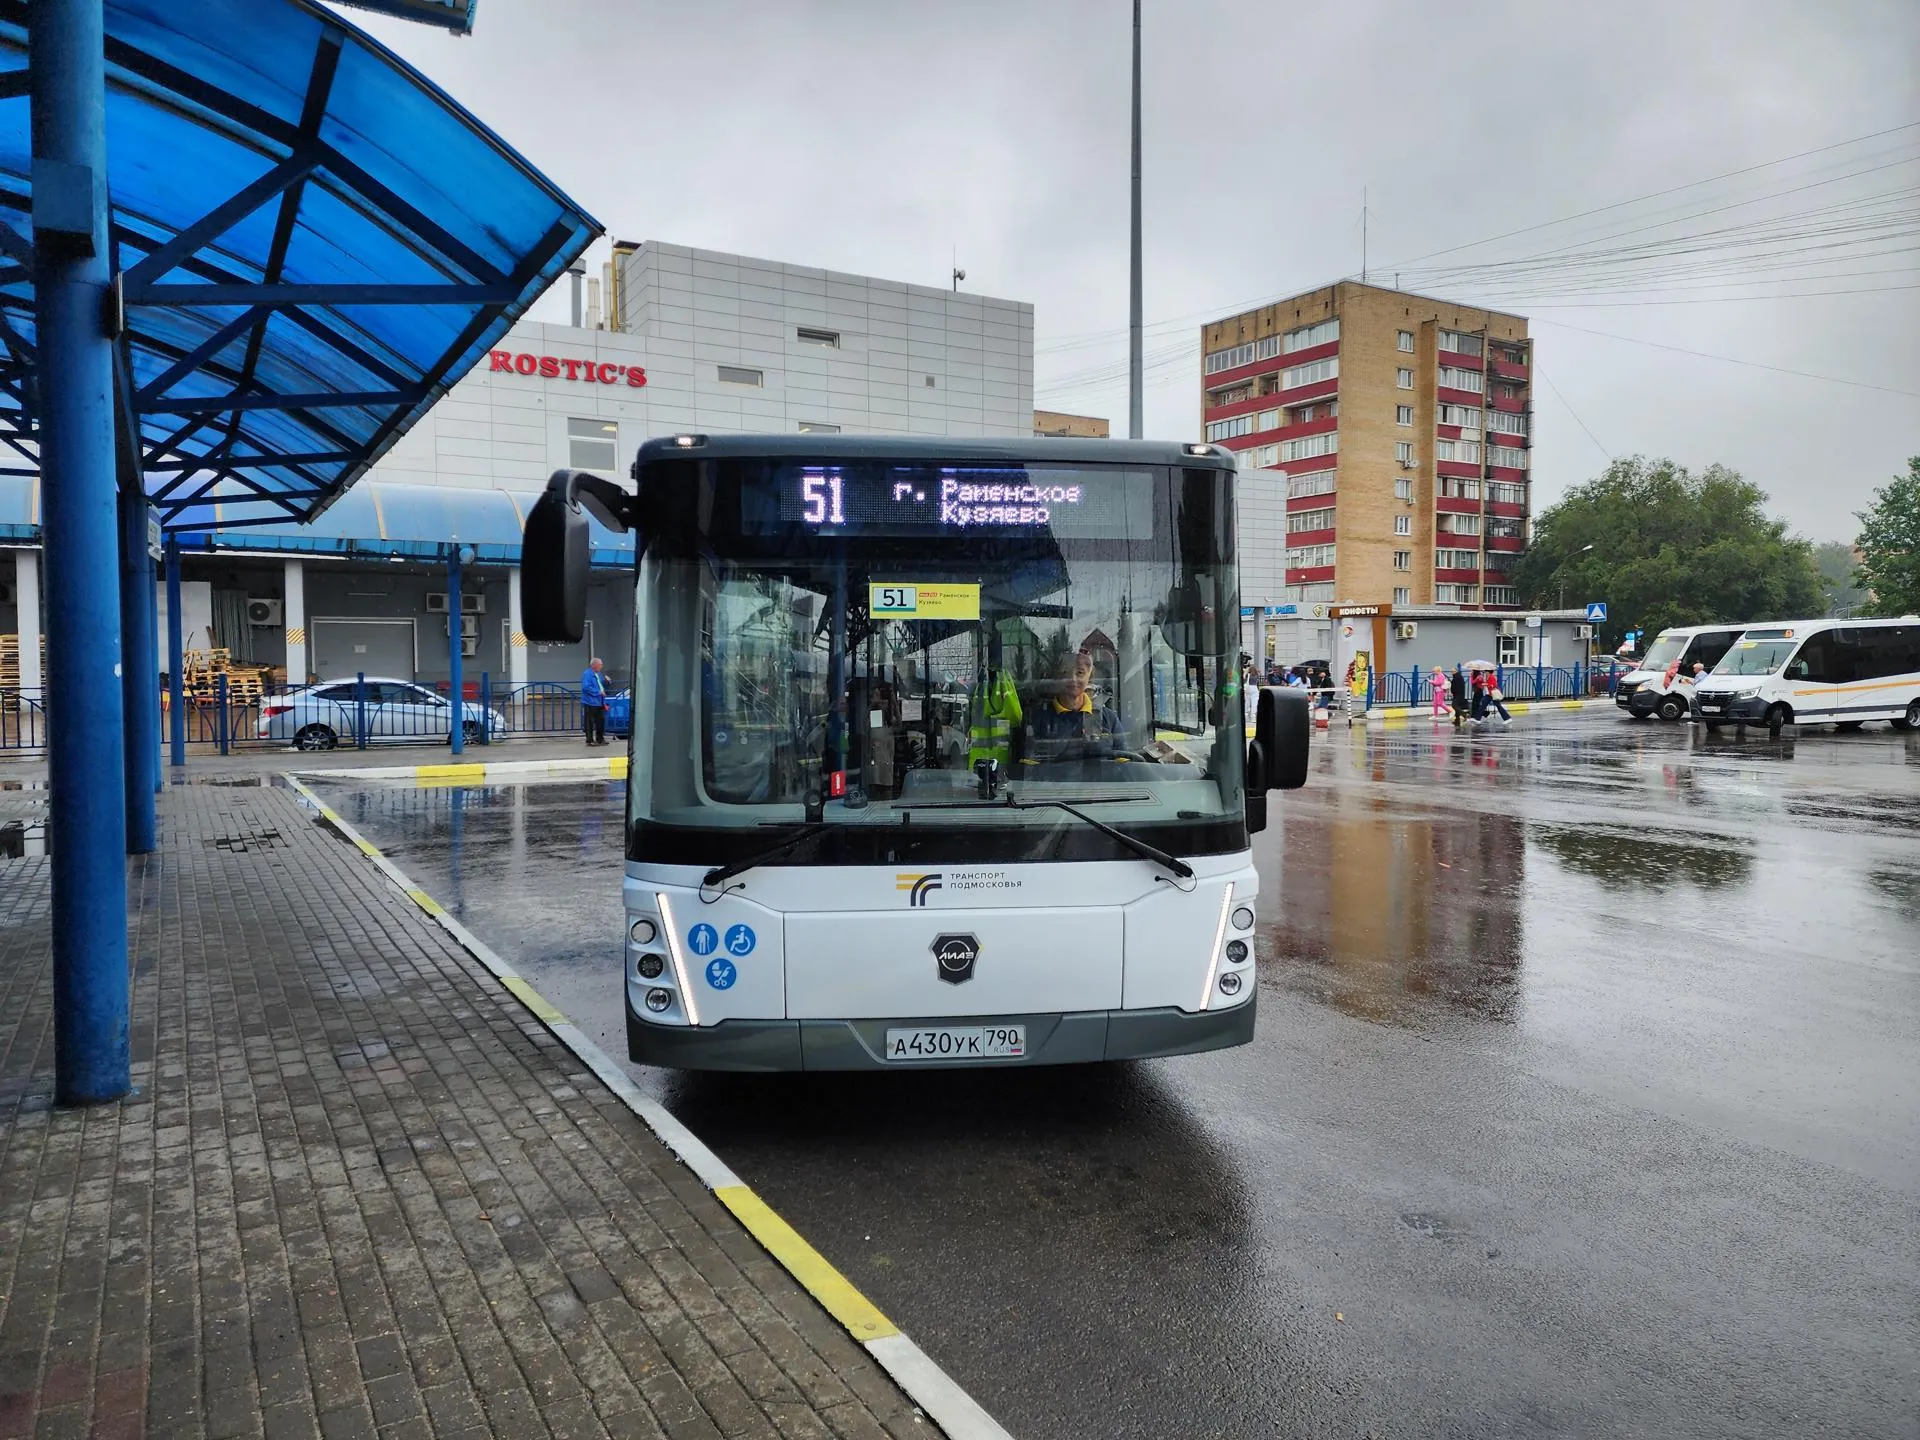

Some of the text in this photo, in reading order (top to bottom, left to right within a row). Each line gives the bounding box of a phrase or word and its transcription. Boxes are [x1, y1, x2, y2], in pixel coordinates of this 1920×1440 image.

[489, 349, 648, 388] ROSTIC'S
[803, 476, 844, 524] 51
[894, 479, 1082, 502] г. Раменское
[940, 502, 1050, 527] Кузяево
[882, 588, 908, 607] 51
[1339, 606, 1379, 616] КОНФЕТЫ
[950, 872, 1006, 880] ТРАНСПОРТ
[950, 881, 1022, 889] ПОДМОСКОВЬЯ
[938, 951, 974, 960] ЛИАЗ
[894, 1029, 1019, 1055] А430УК 790
[993, 1046, 1011, 1054] RUS
